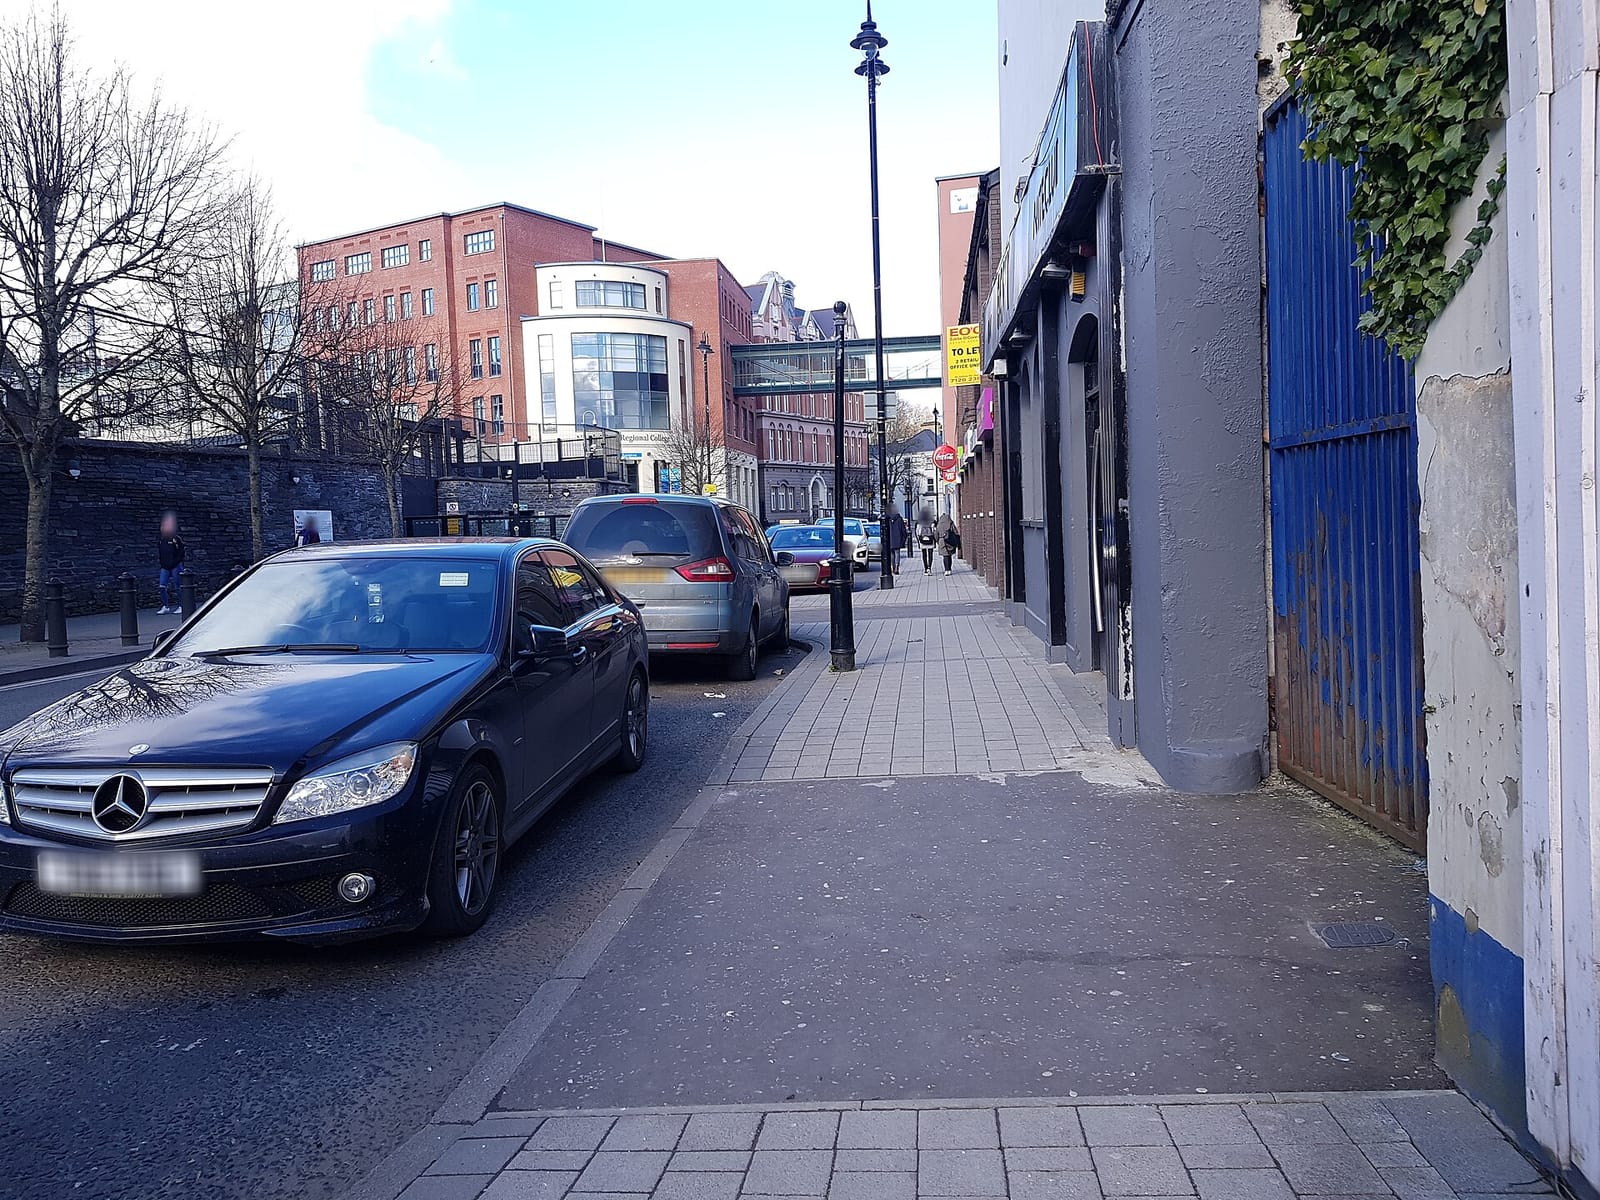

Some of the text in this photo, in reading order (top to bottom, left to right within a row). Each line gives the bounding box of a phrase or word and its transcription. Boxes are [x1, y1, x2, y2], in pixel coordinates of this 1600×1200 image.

[952, 348, 963, 356] TO
[620, 434, 671, 443] Regional College
